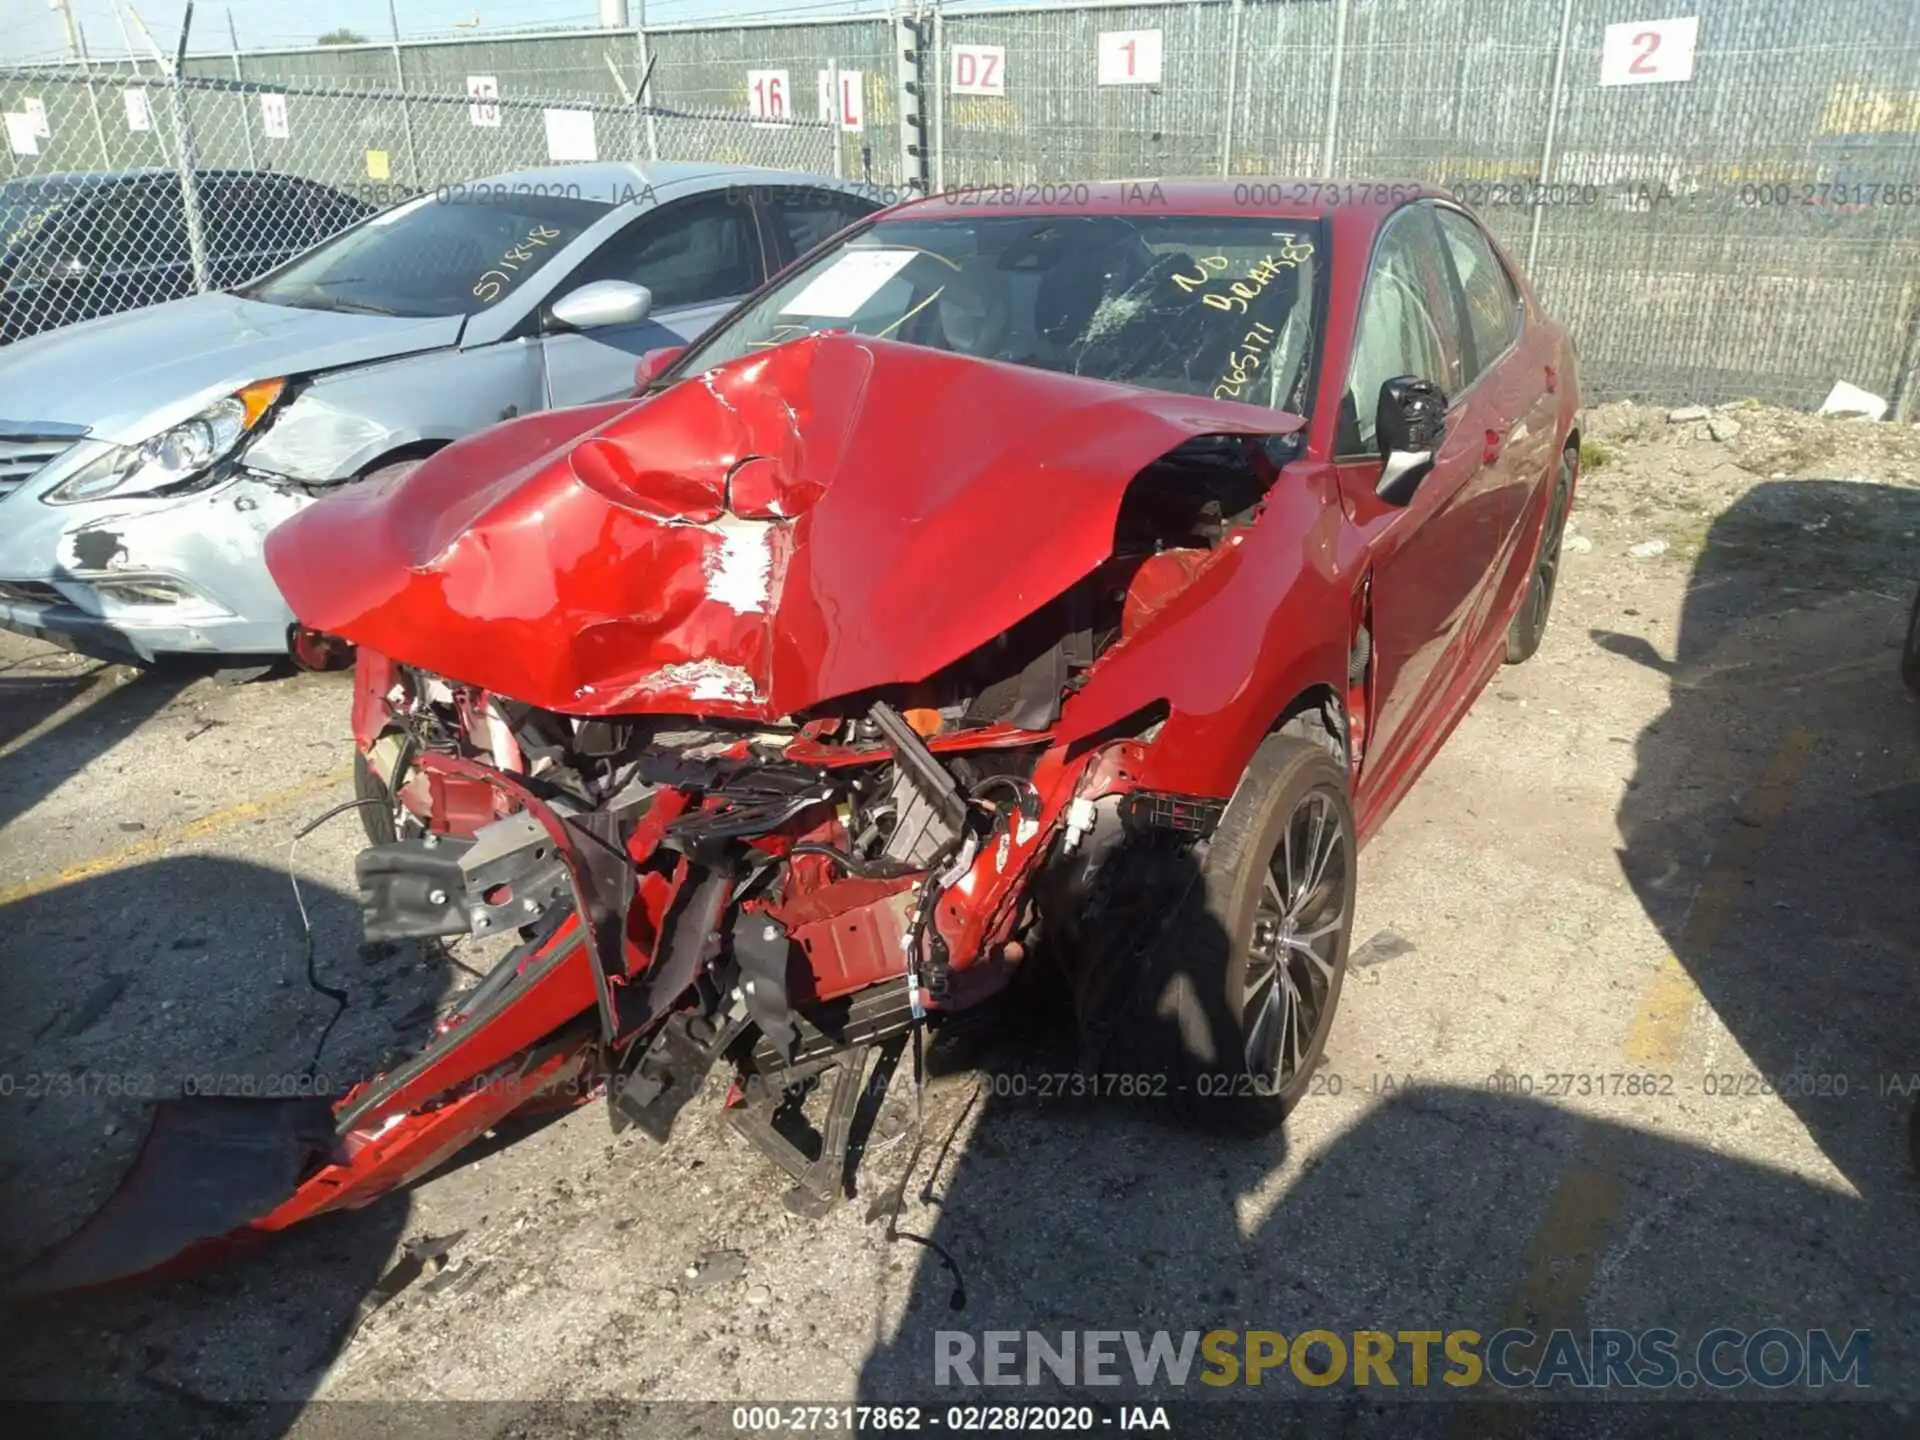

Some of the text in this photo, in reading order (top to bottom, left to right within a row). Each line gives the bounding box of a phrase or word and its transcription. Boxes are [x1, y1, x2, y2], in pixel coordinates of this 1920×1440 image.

[957, 53, 999, 88] DZ
[1117, 38, 1135, 76] 1
[1628, 31, 1661, 74] 2
[754, 78, 782, 118] 16
